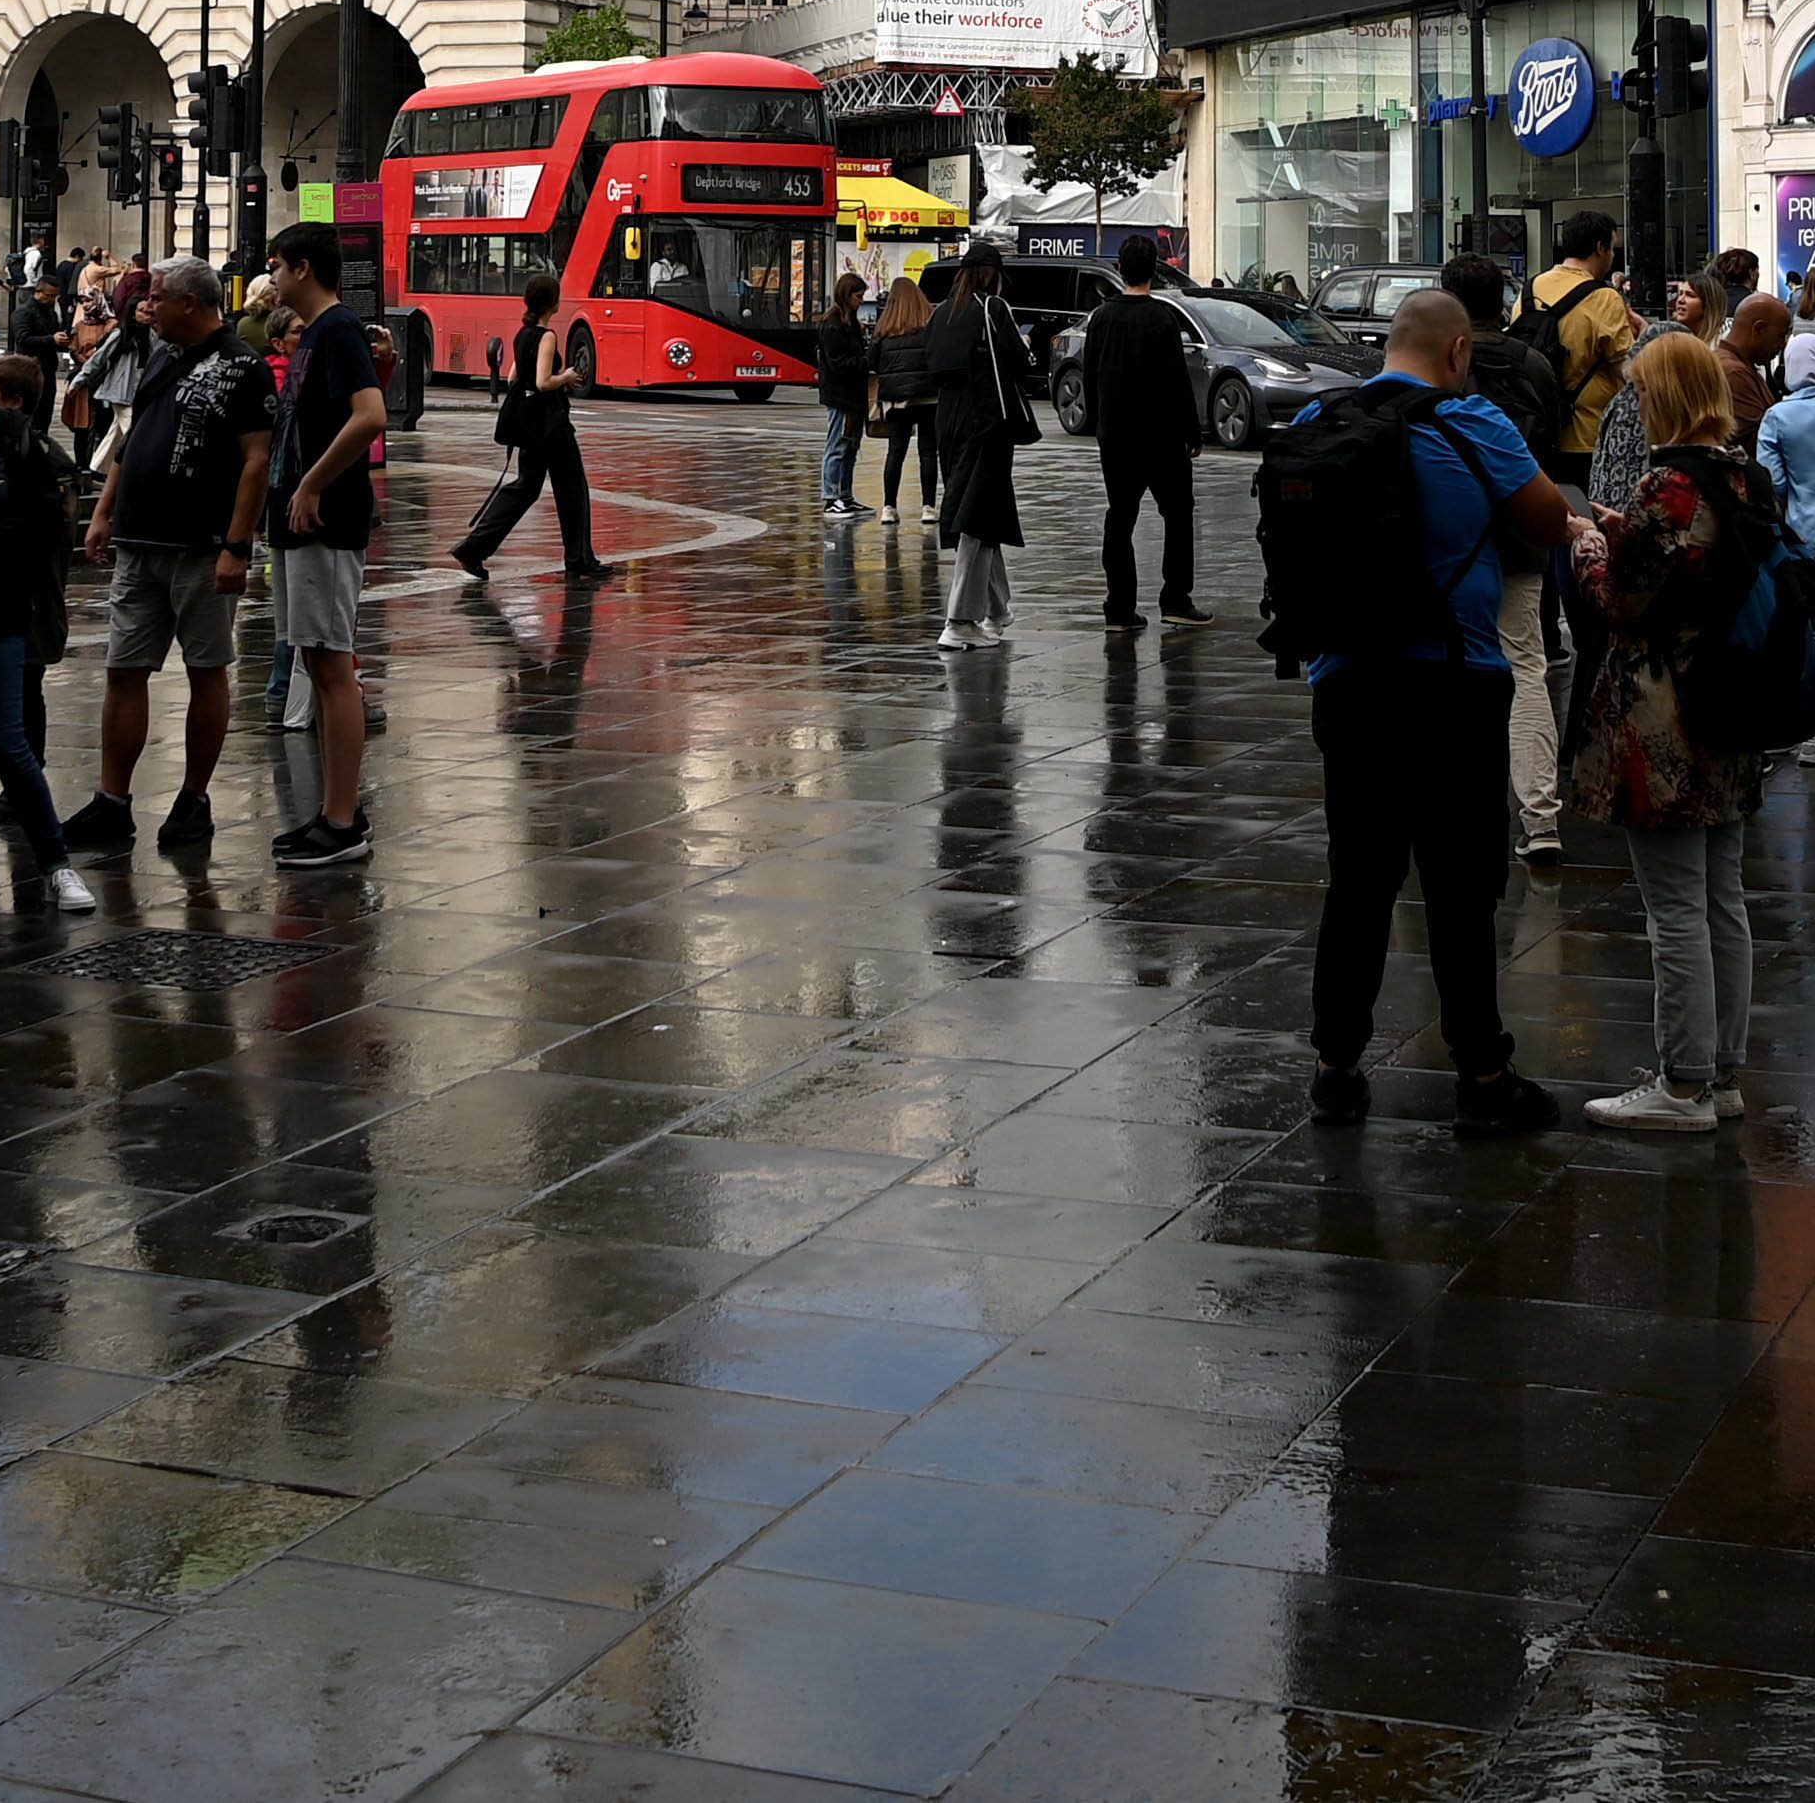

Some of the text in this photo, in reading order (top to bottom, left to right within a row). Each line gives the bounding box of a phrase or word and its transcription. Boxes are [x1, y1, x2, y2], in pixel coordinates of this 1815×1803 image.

[877, 7, 1043, 29] alue their workforce
[1513, 55, 1578, 136] Boots
[1428, 94, 1499, 128] pharmy
[861, 163, 881, 172] HERE
[608, 177, 621, 202] Go
[695, 175, 811, 197] Deptford Bridge 453
[890, 210, 920, 223] DOG
[1028, 238, 1085, 256] PRIME
